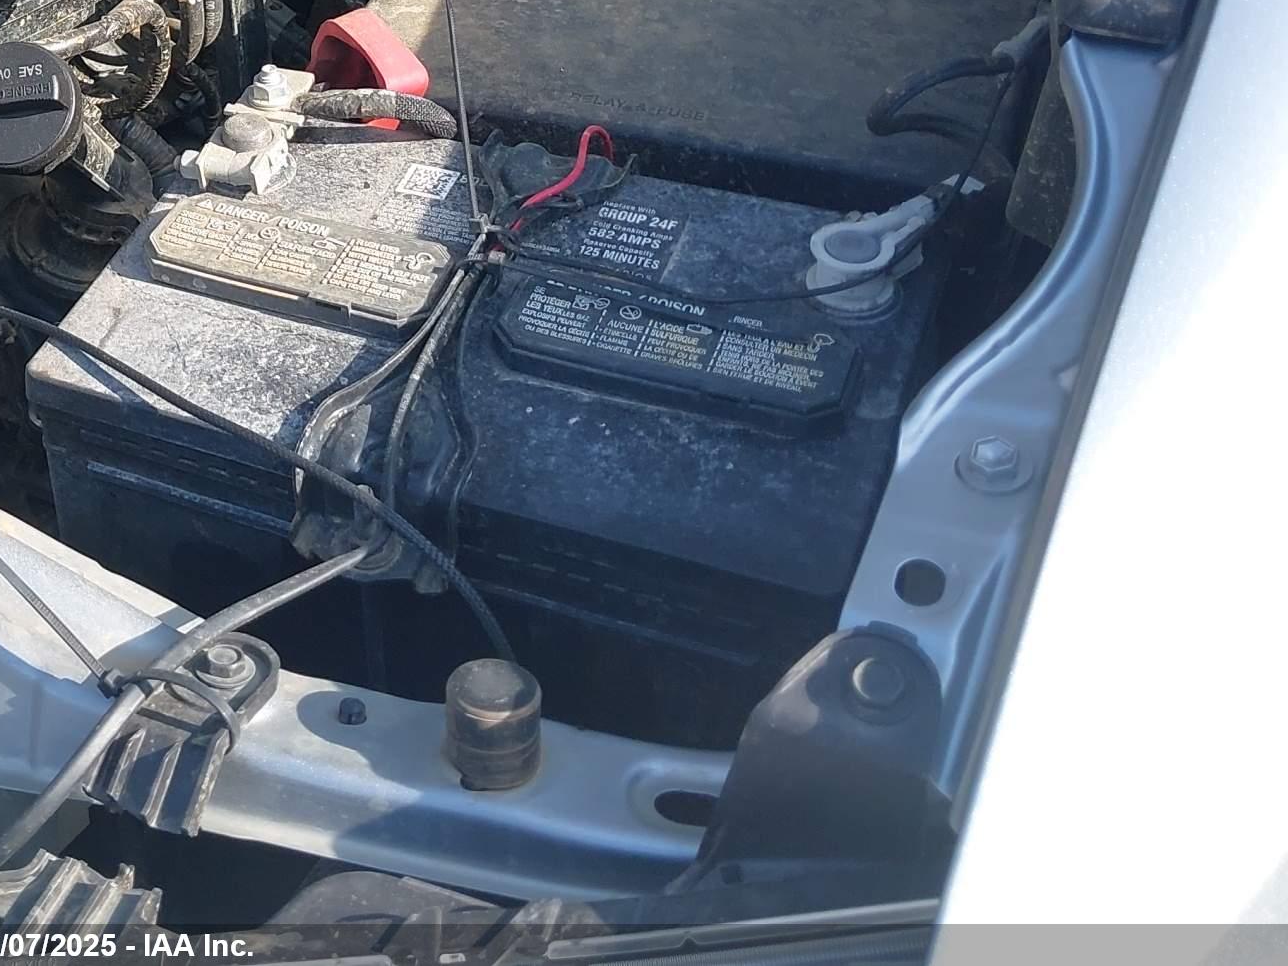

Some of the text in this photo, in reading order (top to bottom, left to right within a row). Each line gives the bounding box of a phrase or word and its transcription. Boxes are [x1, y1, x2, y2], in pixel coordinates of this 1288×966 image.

[19, 64, 43, 78] SAE
[571, 91, 626, 108] RELAY
[655, 107, 705, 121] FUSE
[599, 207, 679, 231] GROUP 24F
[637, 205, 656, 215] With
[589, 227, 662, 250] 582 AMPS
[593, 220, 674, 242] Cold Cranking Amps
[580, 245, 601, 258] 125
[602, 250, 660, 270] MINUTES
[583, 238, 655, 259] Reserve Capacity
[608, 320, 645, 335] AUCUNE
